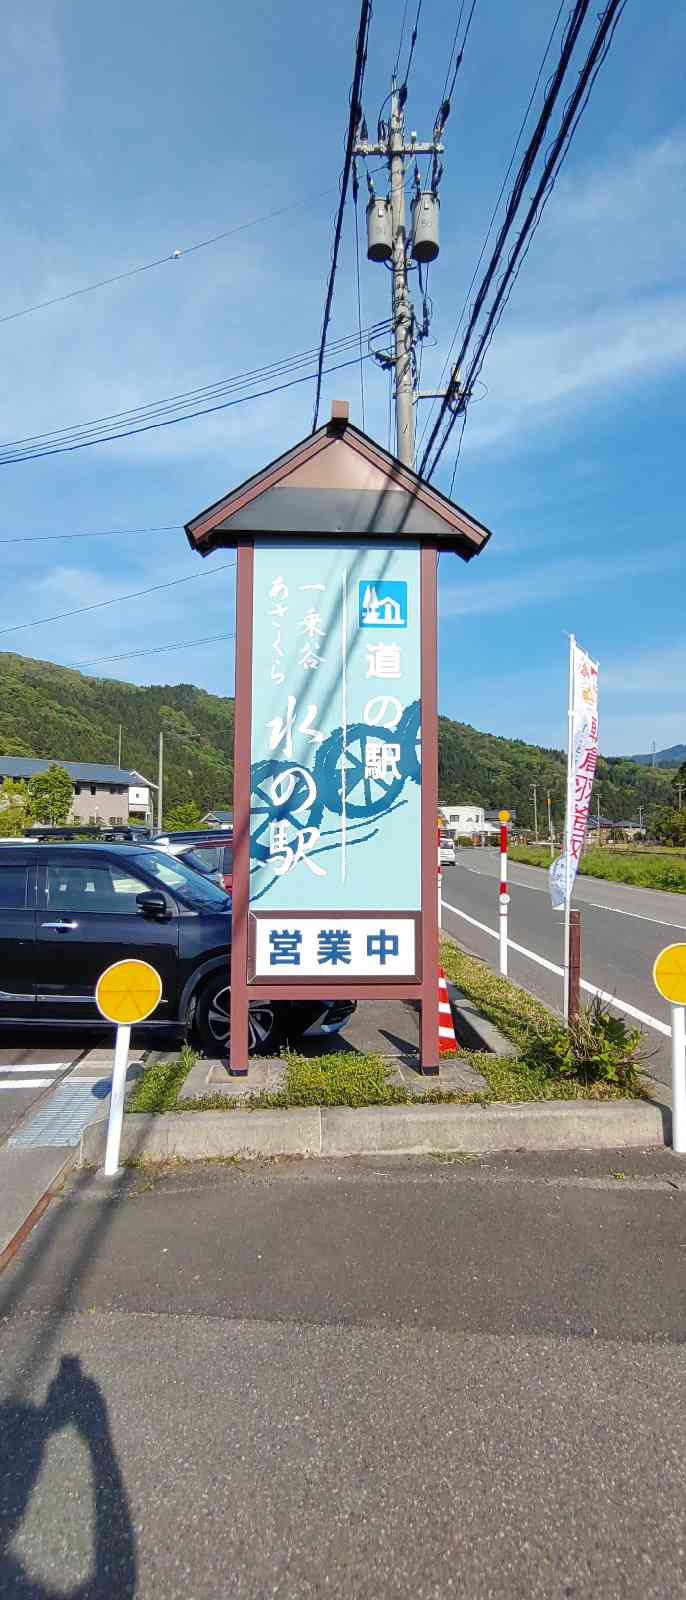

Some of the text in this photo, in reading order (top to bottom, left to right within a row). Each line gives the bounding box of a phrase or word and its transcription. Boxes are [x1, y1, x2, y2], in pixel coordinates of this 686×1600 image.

[266, 575, 289, 688] あさくら
[296, 583, 328, 670] 一乗谷
[363, 641, 403, 784] 道の駅
[266, 695, 328, 877] 水の駅
[269, 929, 399, 966] 営業中
